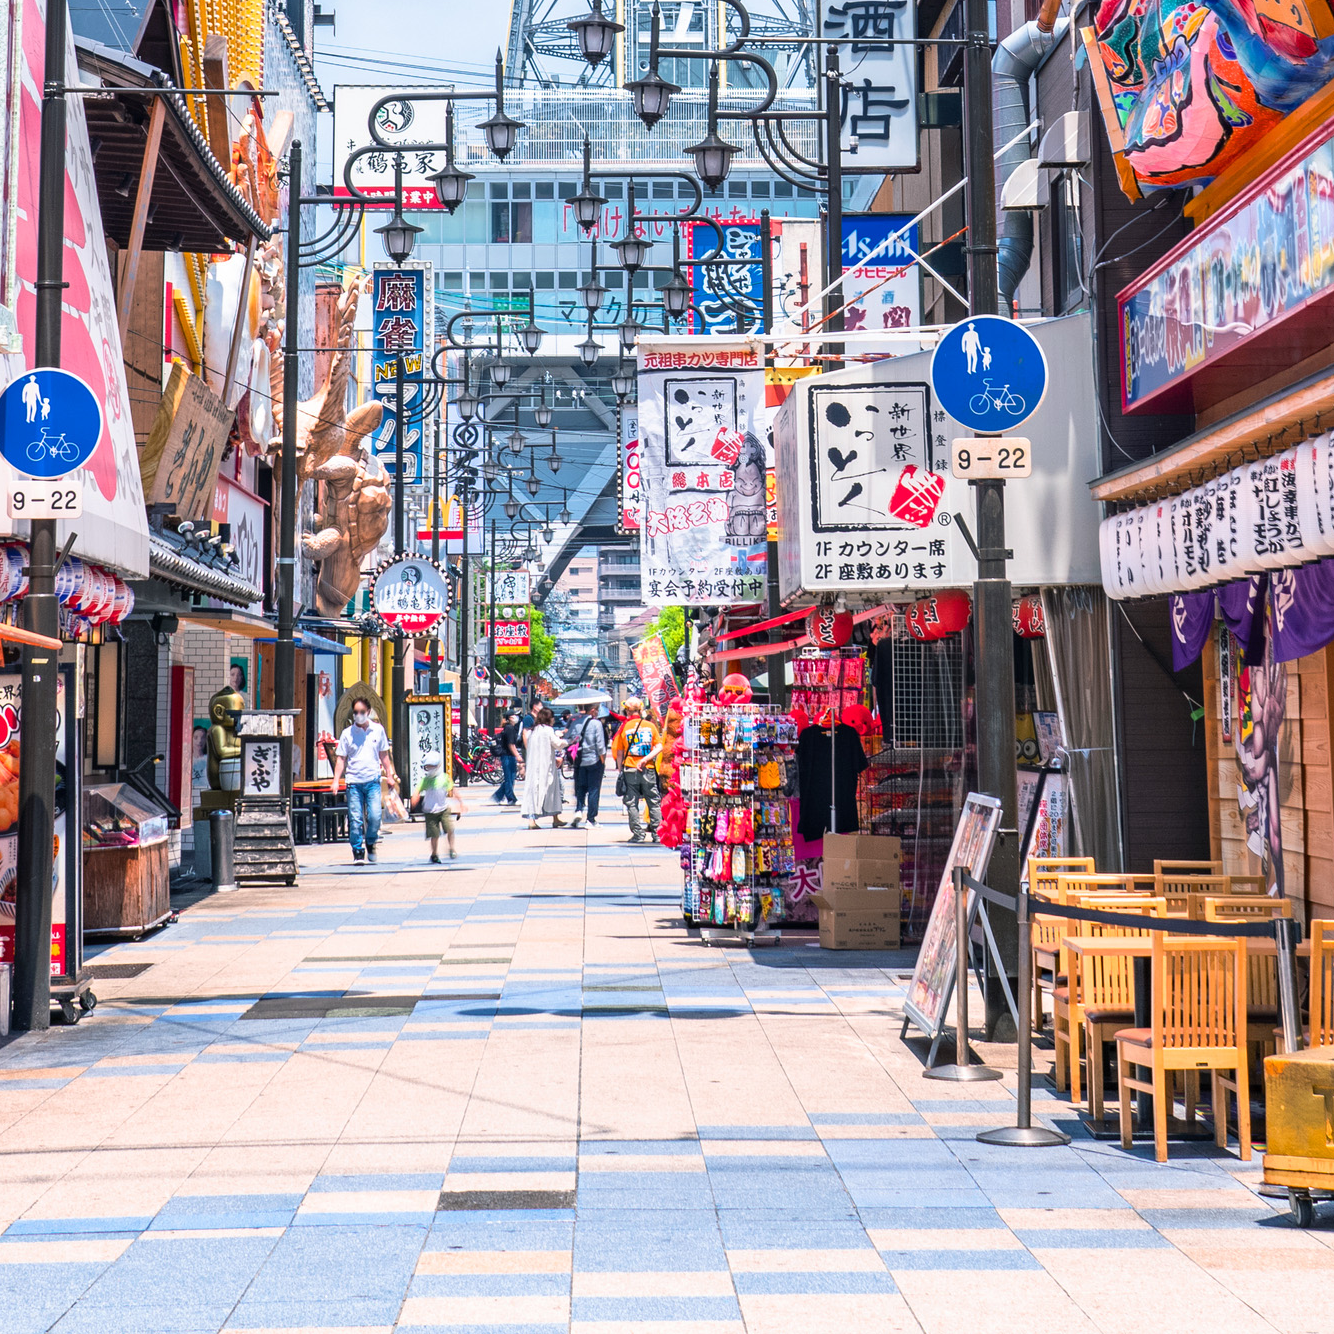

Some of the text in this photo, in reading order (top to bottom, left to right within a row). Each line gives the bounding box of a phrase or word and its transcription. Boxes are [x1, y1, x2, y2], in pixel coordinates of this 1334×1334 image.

[376, 273, 418, 355] 麻雀
[644, 352, 758, 368] 元祖串カツ専門店
[888, 402, 917, 463] 新世界
[957, 448, 1027, 470] 9-22
[12, 490, 78, 512] 9-22
[815, 539, 946, 557] 1F カウンター席
[815, 562, 947, 581] 2F 座敷あります
[647, 578, 764, 598] 宴会予約受付中
[250, 744, 272, 793] ぎふや
